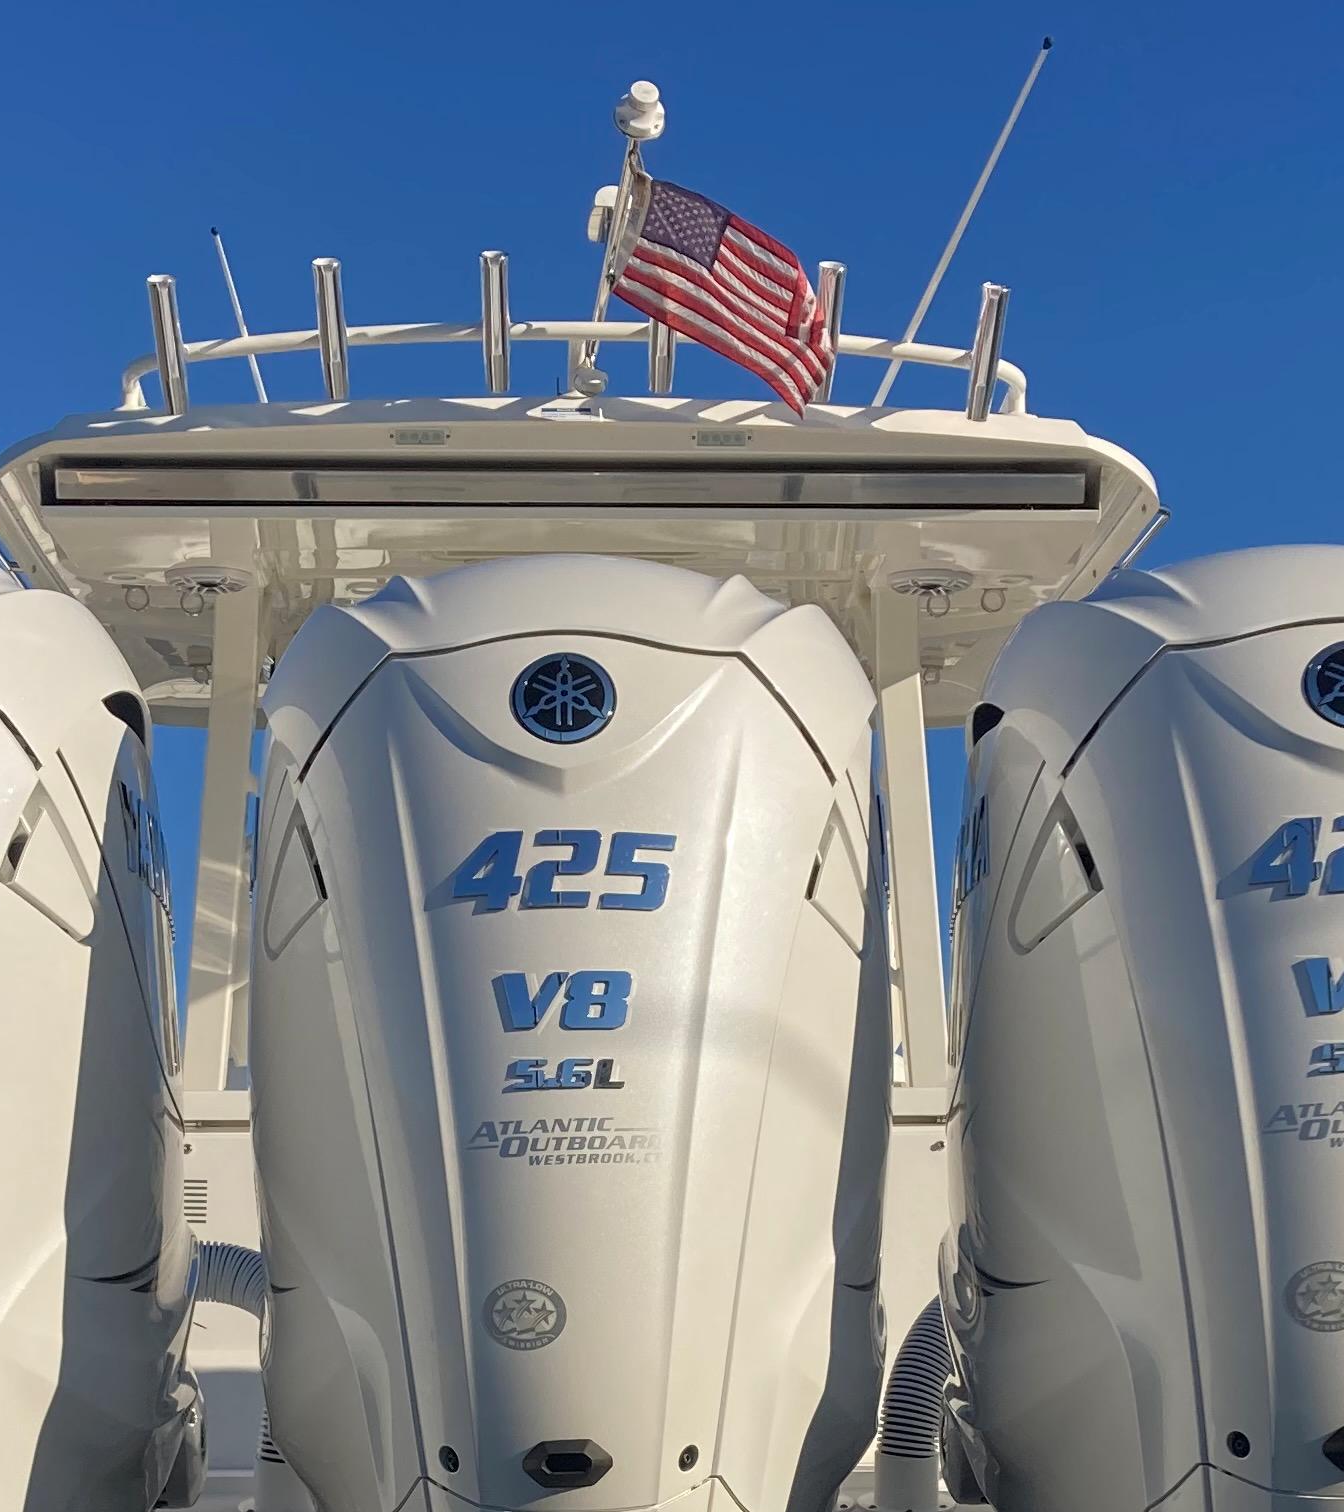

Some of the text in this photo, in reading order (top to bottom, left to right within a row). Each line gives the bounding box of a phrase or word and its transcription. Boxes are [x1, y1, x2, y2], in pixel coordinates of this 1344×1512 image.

[430, 829, 677, 916] 425
[492, 970, 633, 1032] V8
[503, 1058, 625, 1094] 5.6L
[470, 1117, 613, 1143] ATLANTIC
